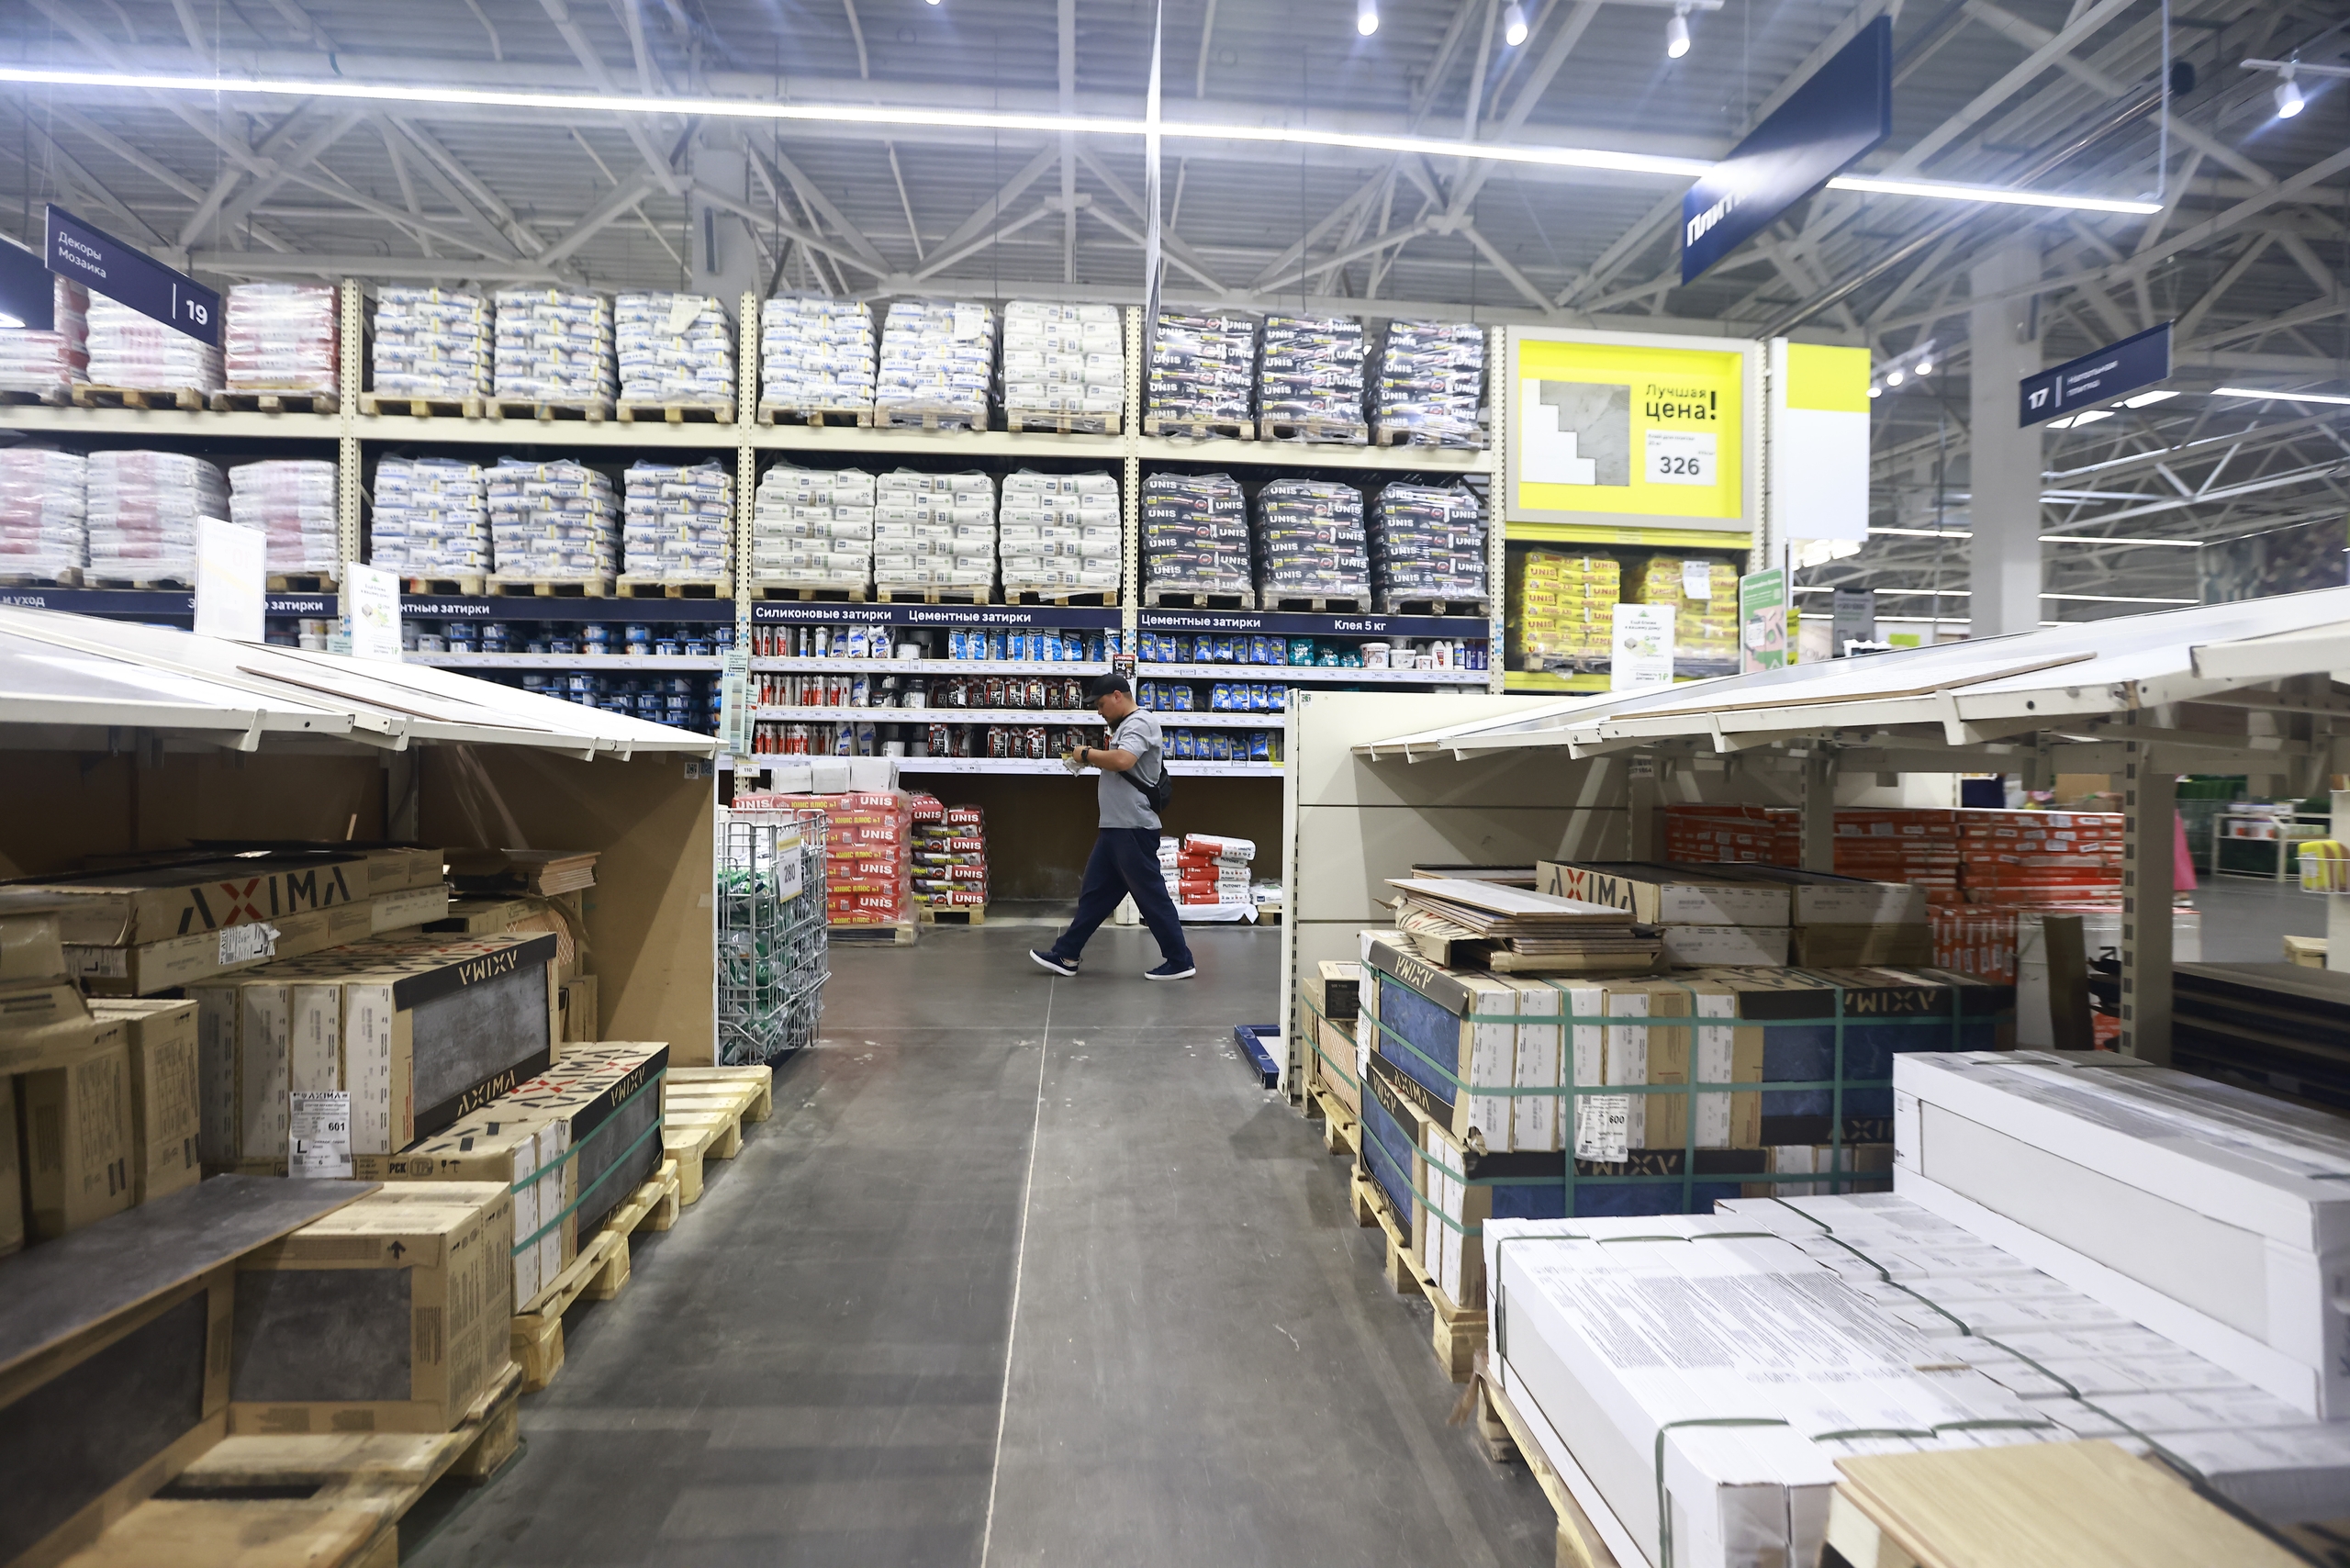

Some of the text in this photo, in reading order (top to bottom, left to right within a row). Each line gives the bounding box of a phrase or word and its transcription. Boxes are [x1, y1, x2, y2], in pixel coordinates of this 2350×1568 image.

[58, 231, 102, 261] Декоры
[58, 248, 107, 279] Мозаика
[185, 299, 209, 326] 19
[1228, 348, 1254, 358] UNIS
[1337, 351, 1363, 360] UNIS
[1153, 355, 1181, 364] UNIS
[1385, 364, 1412, 373] UNIS
[1150, 383, 1177, 391] UNIS
[1337, 377, 1362, 386] UNIS
[1455, 384, 1480, 394] UNIS
[1646, 384, 1707, 399] Лучшая
[2028, 387, 2049, 409] 17
[1646, 390, 1716, 421] цена!
[1660, 456, 1699, 476] 326
[1452, 510, 1477, 519] UNIS
[1219, 529, 1246, 537] UNIS
[1338, 532, 1364, 541] UNIS
[1149, 539, 1177, 547] UNIS
[1221, 556, 1248, 565] UNIS
[1341, 559, 1367, 568] UNIS
[1154, 566, 1181, 574] UNIS
[1459, 564, 1483, 572] UNIS
[15, 595, 46, 607] уход
[273, 599, 324, 612] затирки
[400, 602, 490, 615] нтные затирки
[755, 607, 892, 622] Силиконовые затирки
[909, 610, 1032, 624] Цементные затирки
[1141, 614, 1261, 629] Цементные затирки
[1334, 620, 1386, 633] Клея 5 кг
[736, 800, 770, 808] UNIS
[861, 797, 892, 806] UNIS
[861, 830, 893, 839] UNIS
[784, 863, 796, 884] 280
[860, 865, 892, 874] UNIS
[956, 870, 982, 879] UNIS
[1549, 867, 1637, 915] AXIMA
[177, 866, 351, 935] AXIMA
[860, 898, 892, 907] UNIS
[459, 949, 518, 985] AXIMA
[1395, 955, 1434, 990] AXIMA
[610, 1066, 645, 1106] AXIMA
[1394, 1070, 1430, 1111] AXIMA
[457, 1070, 516, 1117] AXIMA
[1609, 1114, 1625, 1124] 600
[328, 1122, 345, 1131] 601
[297, 1139, 308, 1154] L
